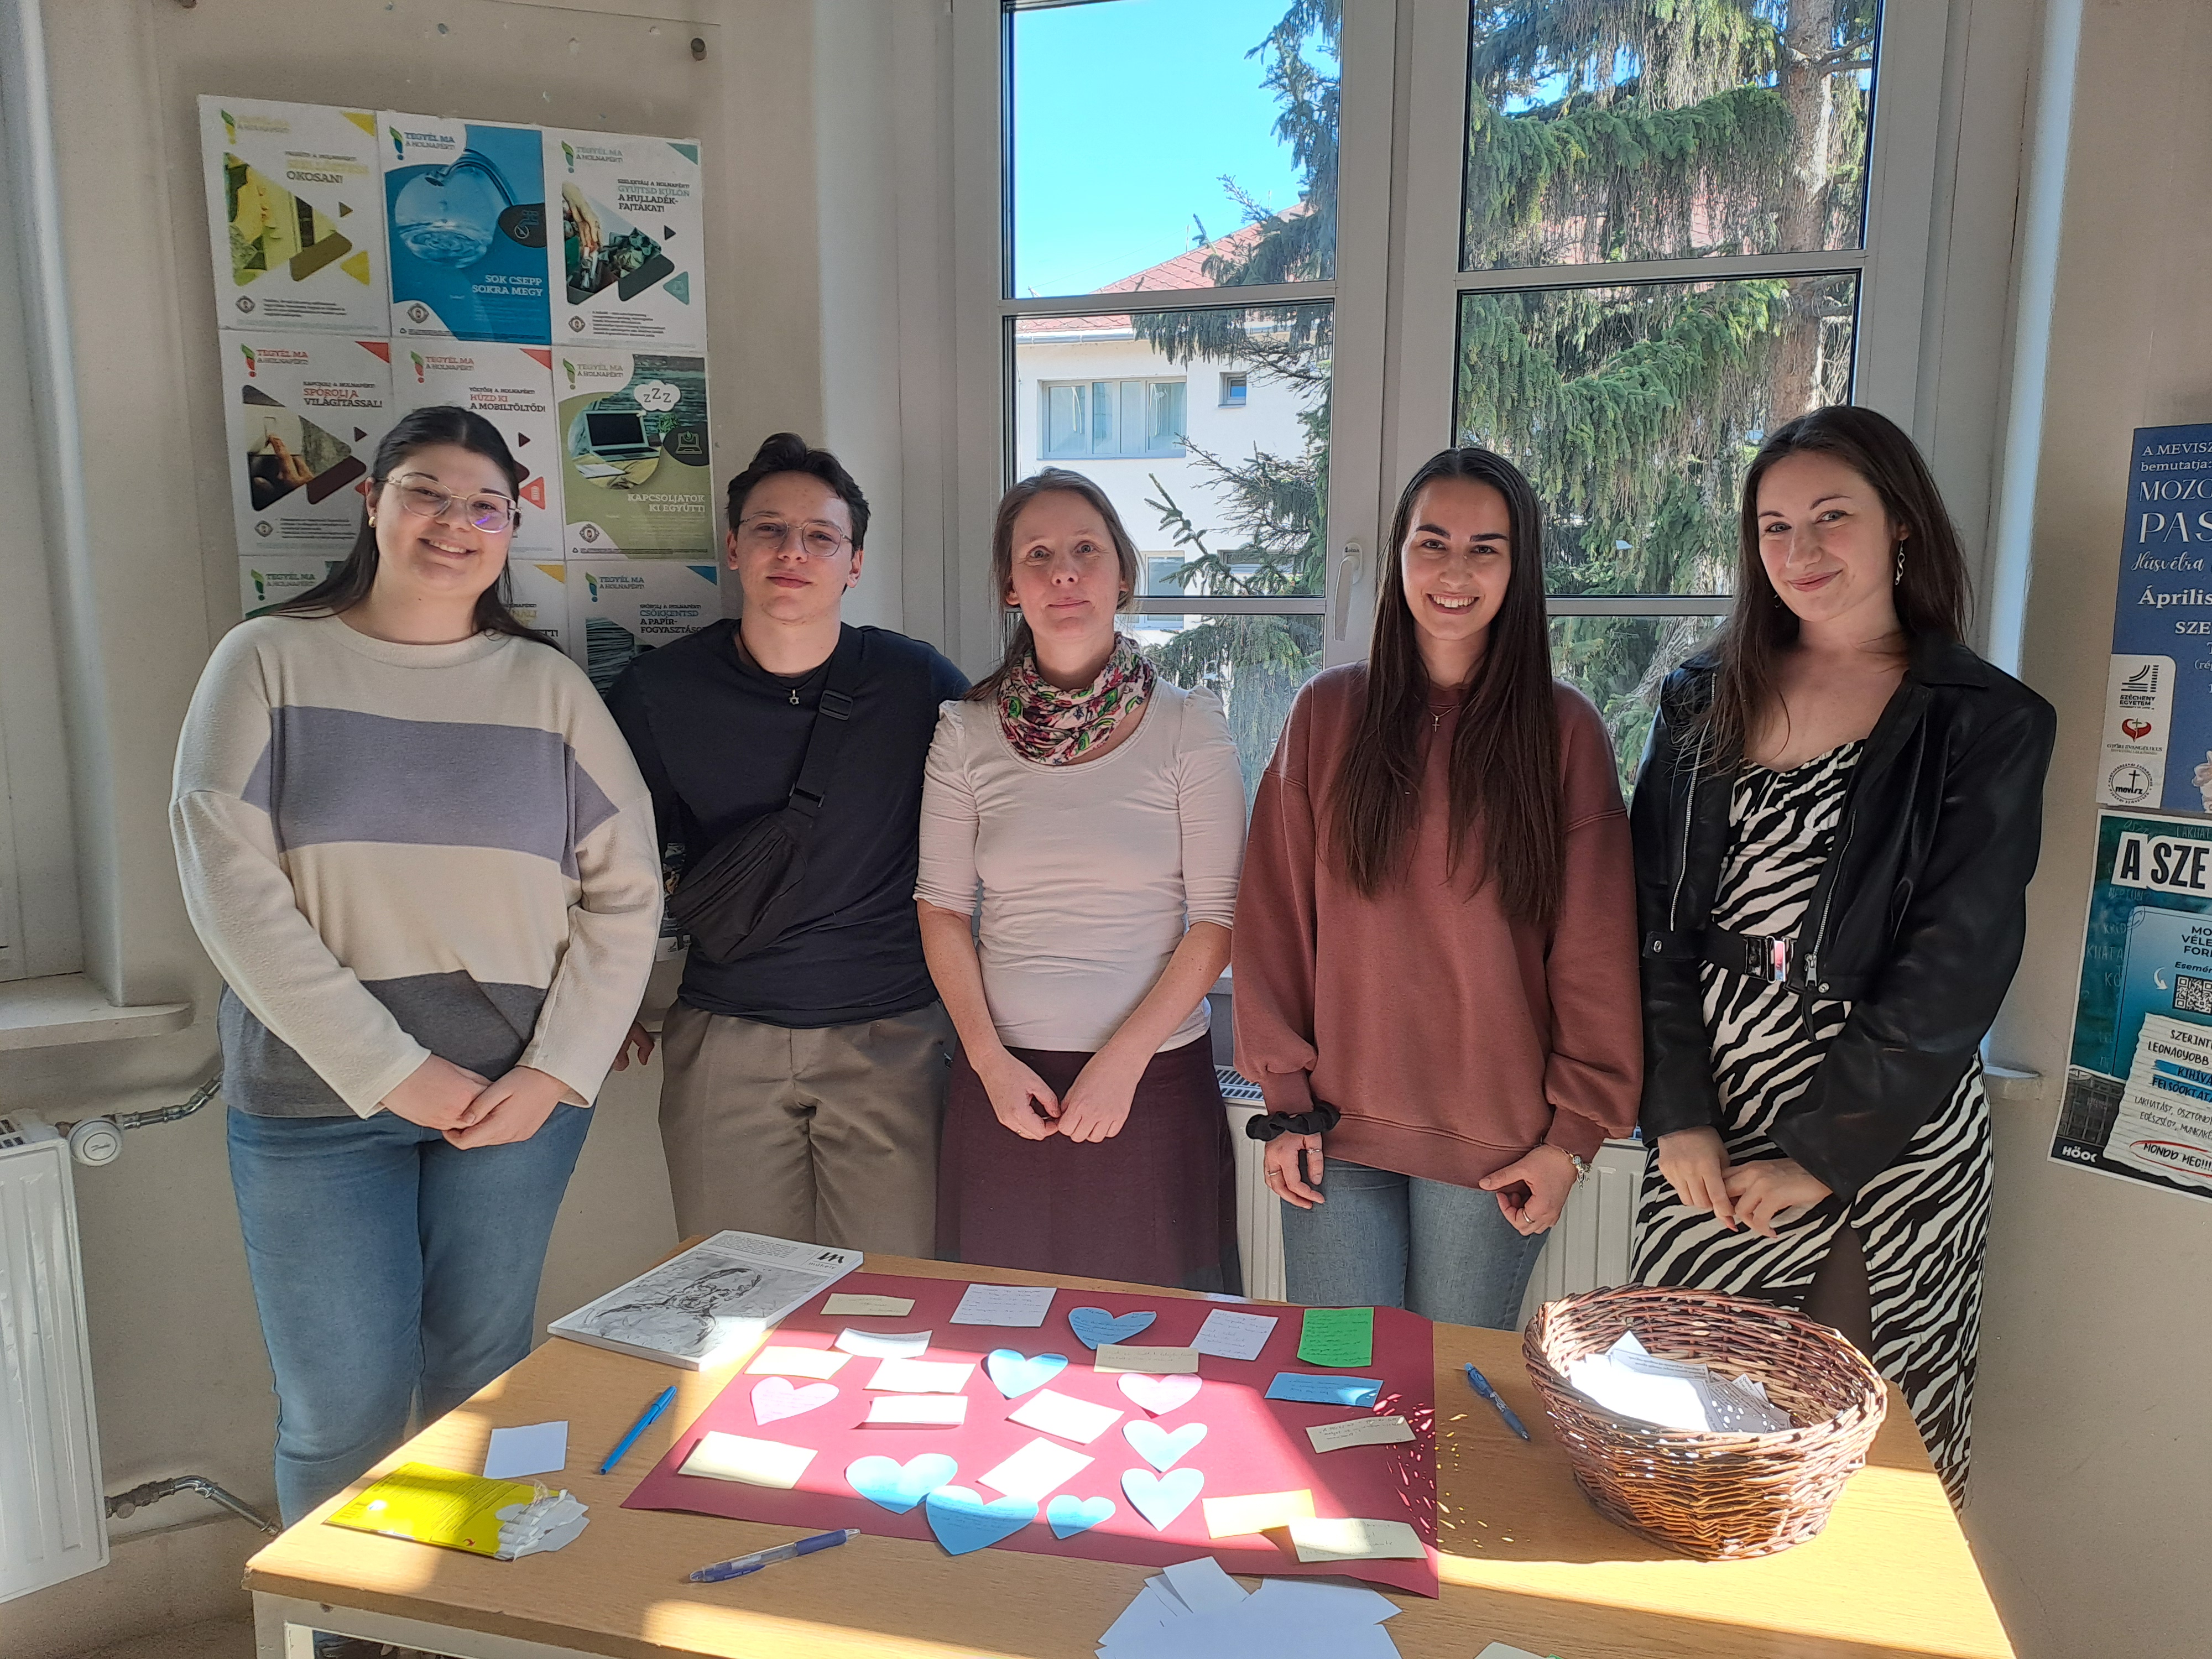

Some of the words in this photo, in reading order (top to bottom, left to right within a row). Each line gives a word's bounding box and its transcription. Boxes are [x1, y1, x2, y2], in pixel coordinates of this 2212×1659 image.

[626, 195, 679, 205] HULLADÉK-
[485, 274, 507, 284] SOK
[509, 276, 542, 286] CSEPP
[472, 284, 509, 295] SOKRA
[511, 286, 543, 296] MEGY
[470, 393, 497, 401] HÚZD
[2141, 446, 2153, 456] A
[2141, 459, 2212, 472] bemutatja:
[628, 493, 705, 503] KAPCSOLJATOK
[648, 504, 661, 512] KI
[2137, 585, 2212, 609] Április
[2120, 839, 2140, 880] A
[2151, 842, 2210, 889] SZE
